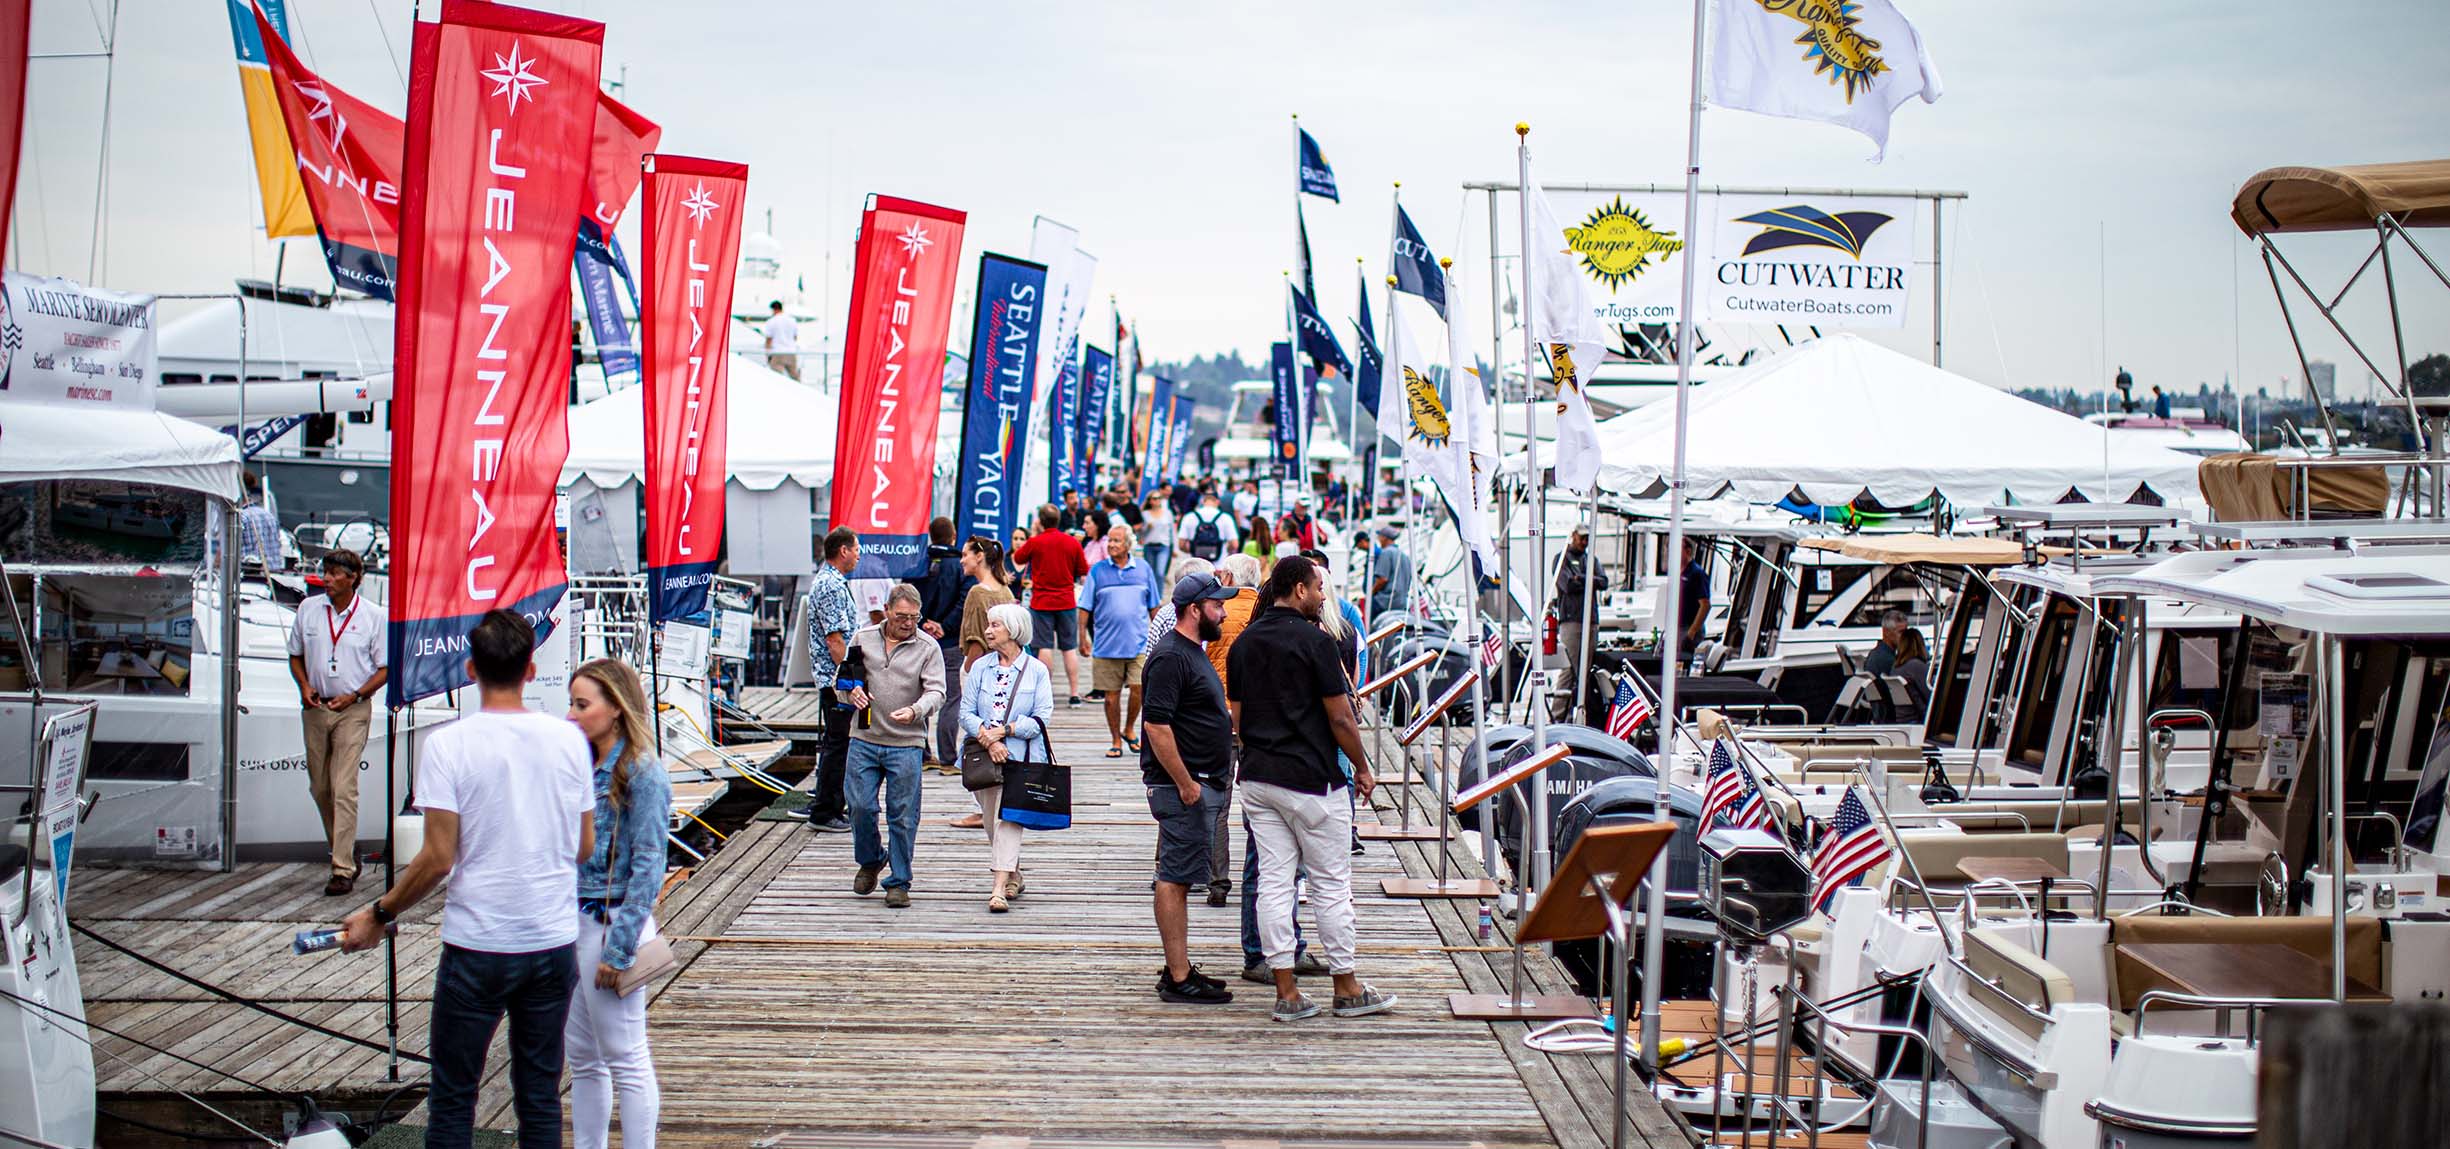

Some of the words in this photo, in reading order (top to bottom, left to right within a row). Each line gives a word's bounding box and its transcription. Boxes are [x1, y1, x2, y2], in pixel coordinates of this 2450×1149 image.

[1816, 28, 1848, 64] QUALITY
[1563, 228, 1635, 261] Ranger
[1642, 231, 1685, 262] Tugs
[1717, 262, 1905, 290] CUTWATER
[25, 286, 81, 320] MARINE
[1726, 296, 1892, 315] CutwaterBoats.com
[32, 352, 55, 371] Seattle
[71, 356, 105, 379] Bellingham
[467, 128, 526, 601] JEANNEAU
[998, 282, 1036, 422] SEATTLE
[678, 238, 710, 556] JEANNEAU
[870, 267, 918, 529] JEANNEAU
[857, 543, 919, 557] NNEAU.COM
[239, 760, 266, 771] SUN
[270, 759, 308, 771] ODYS
[1546, 780, 1593, 795] AMAHA
